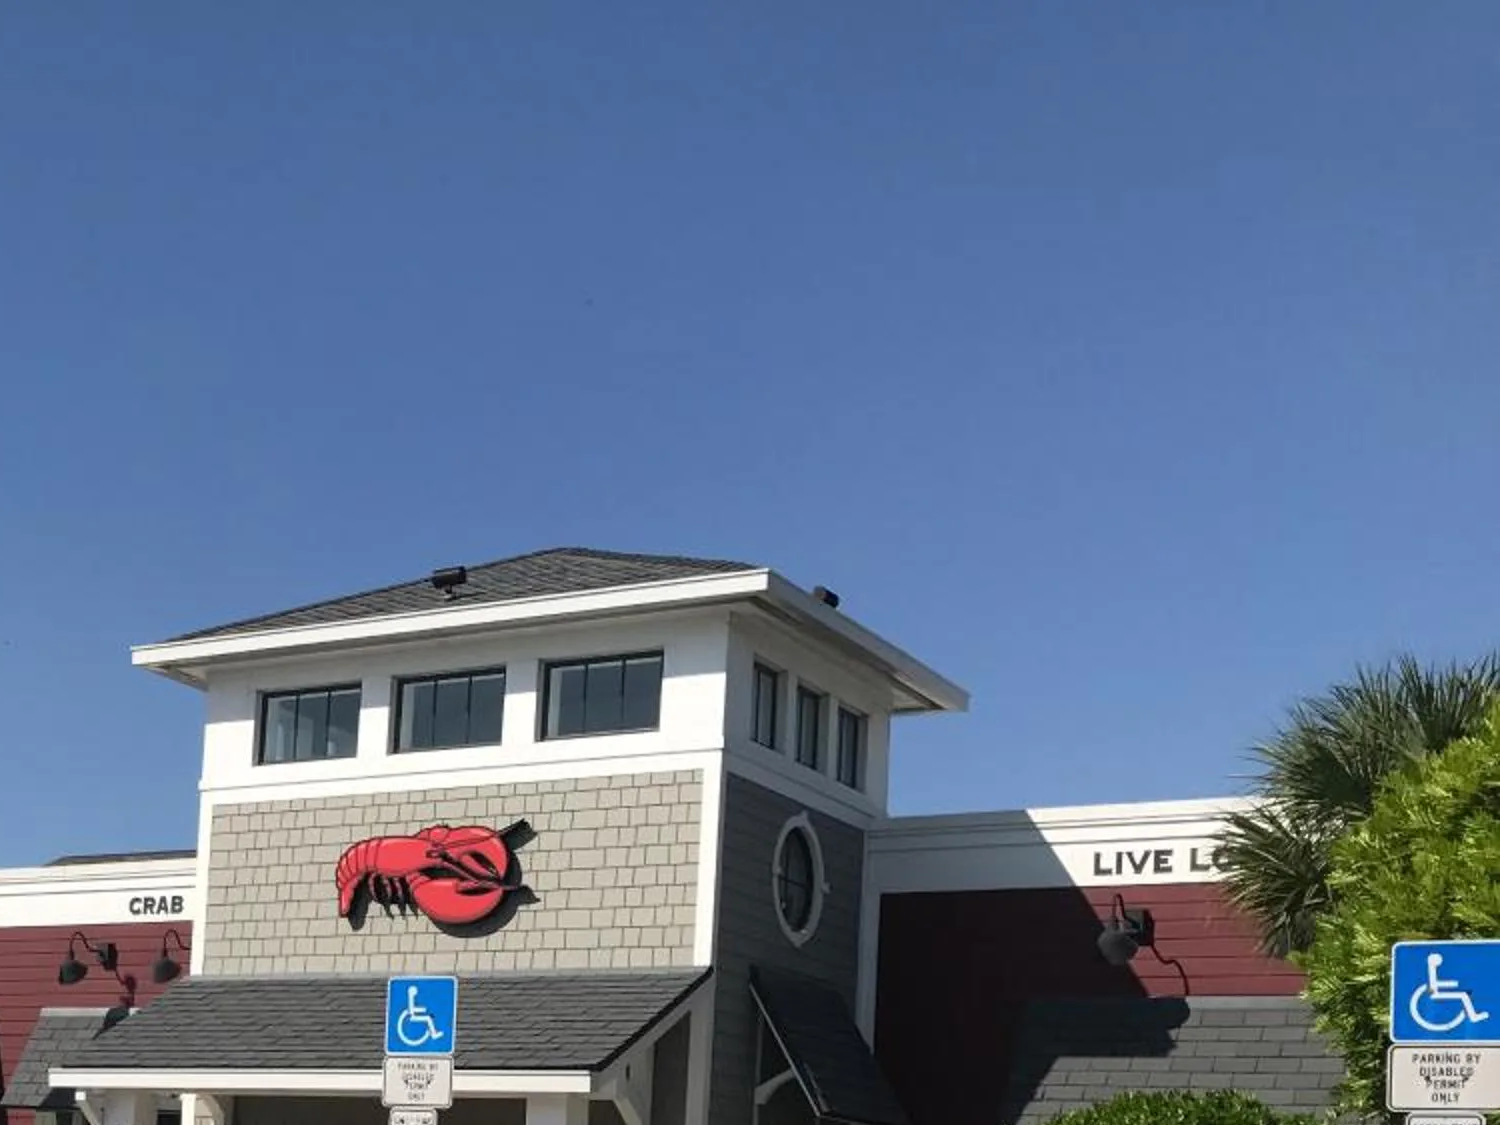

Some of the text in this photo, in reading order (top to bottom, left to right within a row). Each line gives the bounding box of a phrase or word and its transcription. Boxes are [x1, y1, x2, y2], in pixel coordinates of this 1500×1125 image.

[1093, 848, 1174, 877] LIVE
[128, 894, 185, 916] CRAB
[1411, 1053, 1481, 1065] PARKING BY
[1419, 1066, 1475, 1077] DISABLED
[1426, 1078, 1466, 1089] PERMIT
[1431, 1092, 1461, 1104] ONLY
